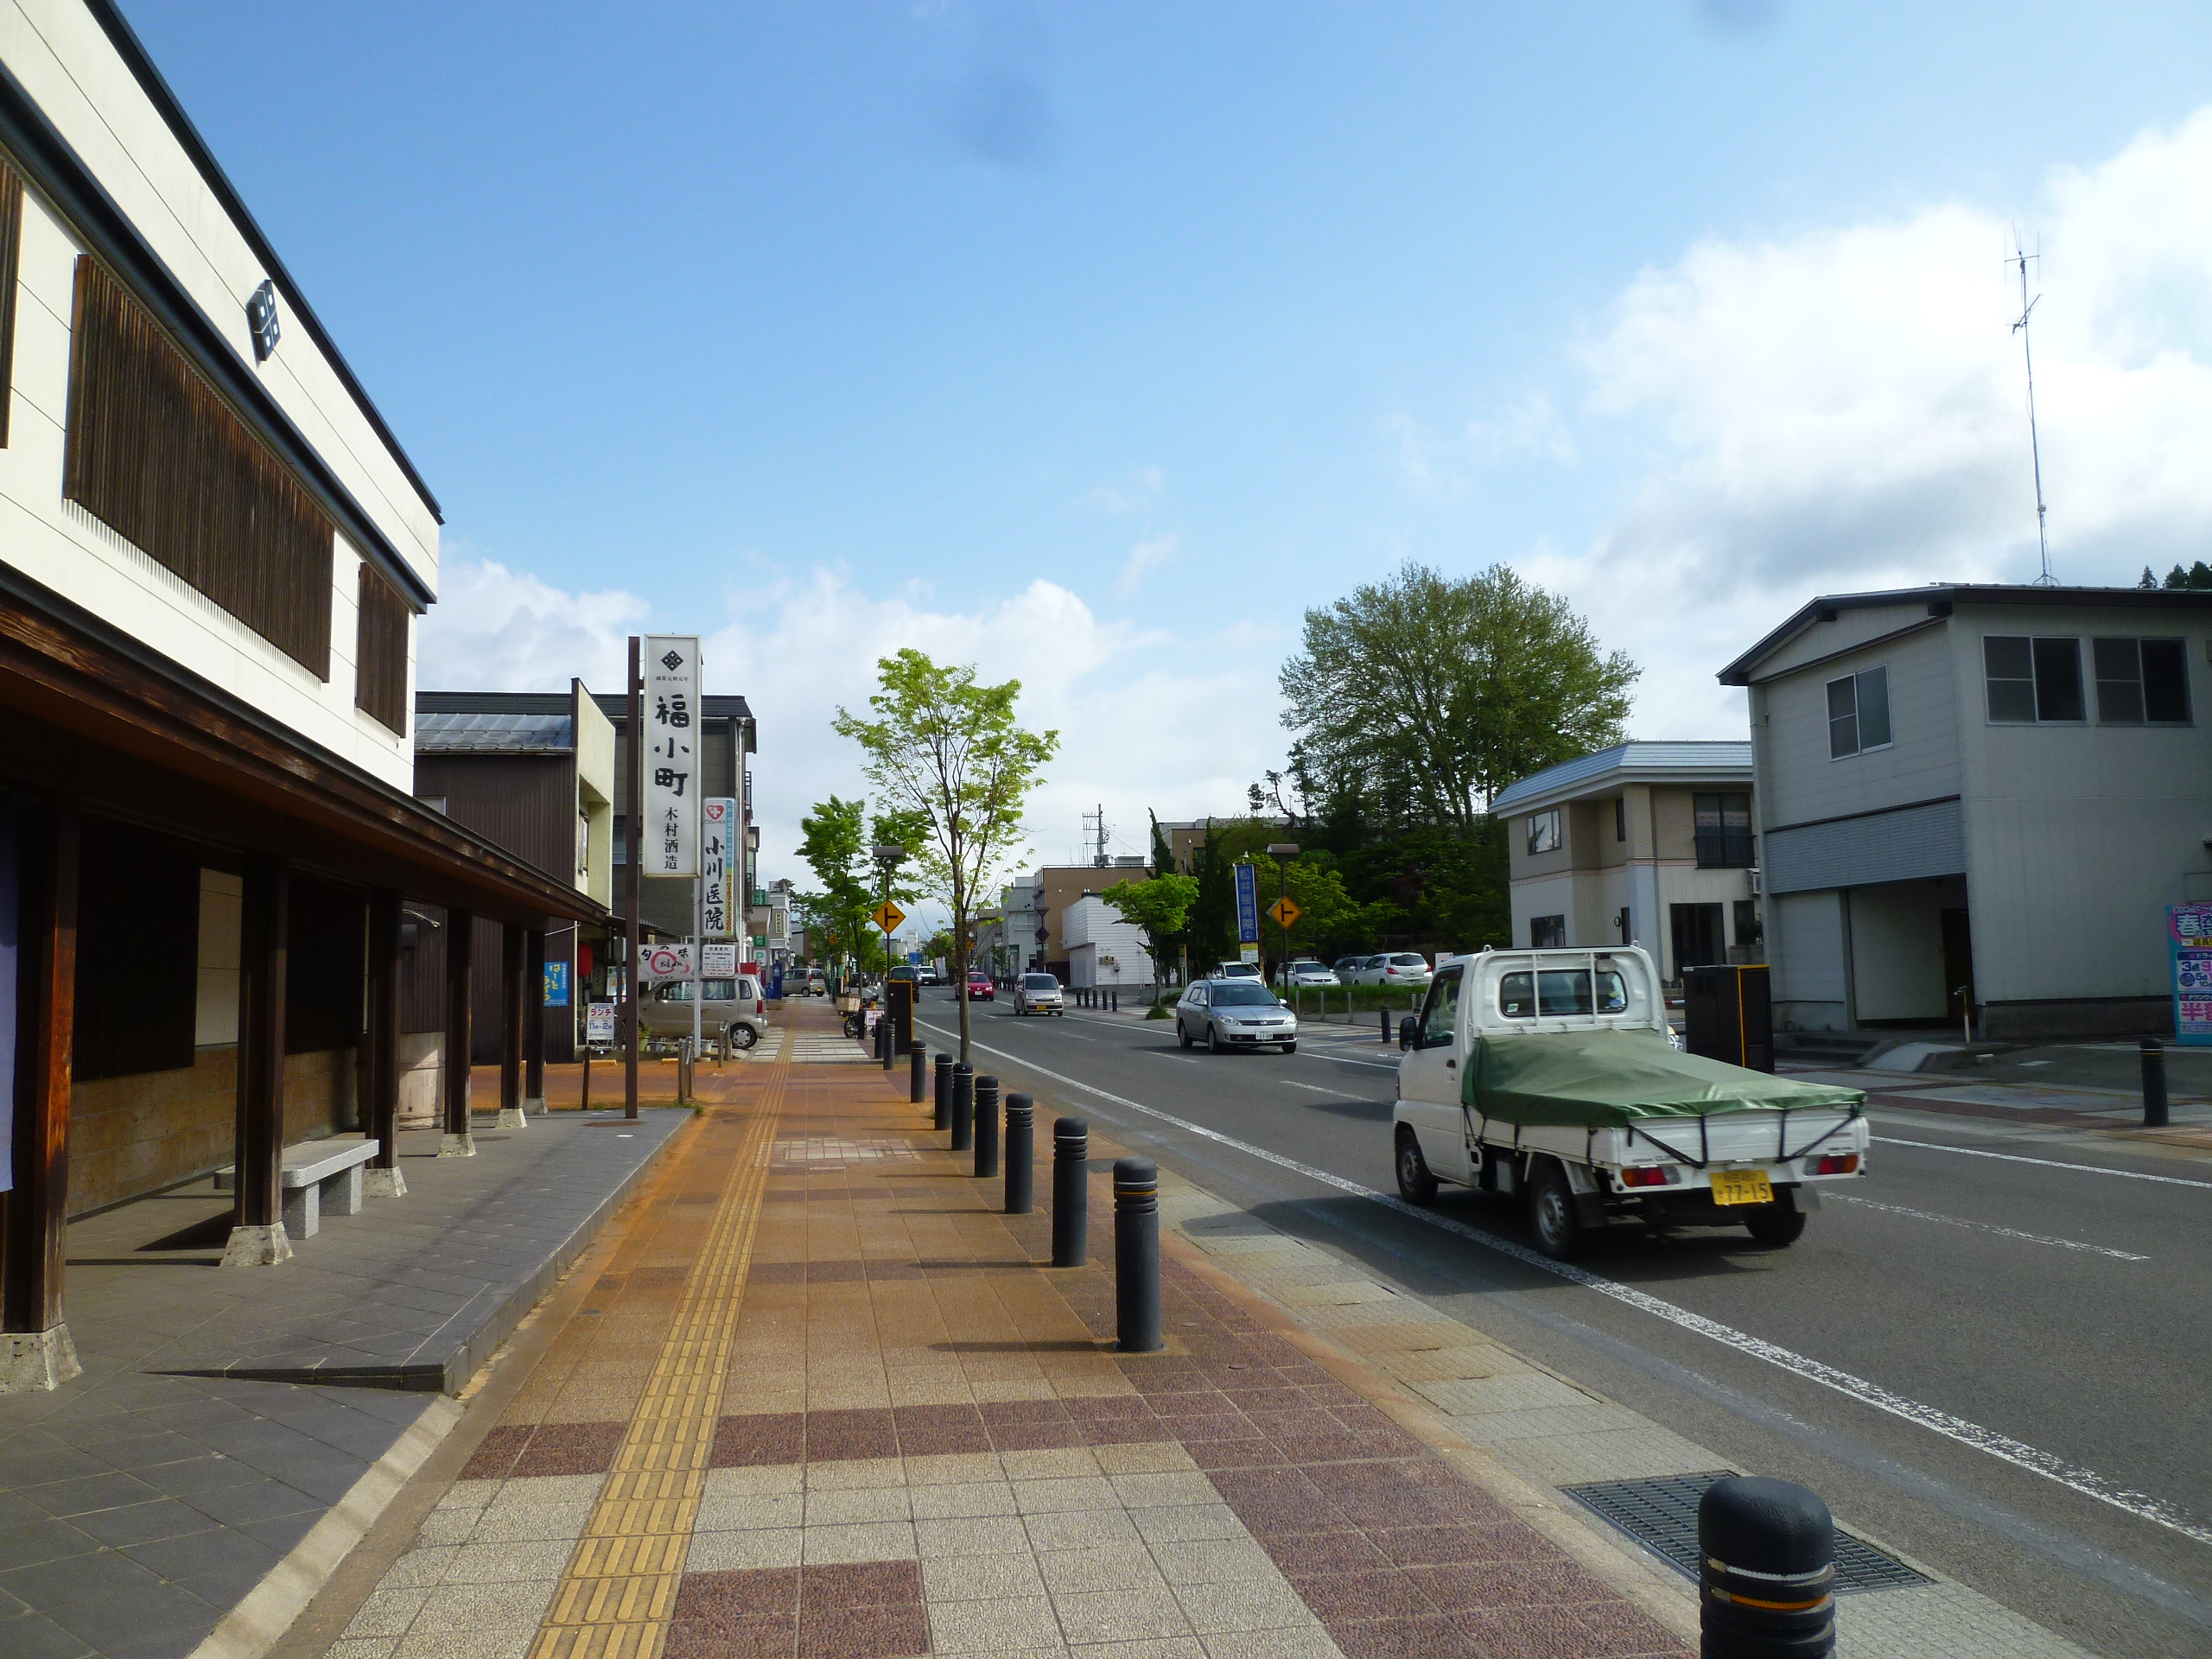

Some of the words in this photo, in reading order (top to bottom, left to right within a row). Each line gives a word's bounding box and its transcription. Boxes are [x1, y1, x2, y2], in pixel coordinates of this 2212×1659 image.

[654, 693, 690, 797] 福小町
[664, 806, 679, 869] 木村酒造
[705, 836, 725, 931] 小川医院
[1724, 1182, 1769, 1202] 77-15
